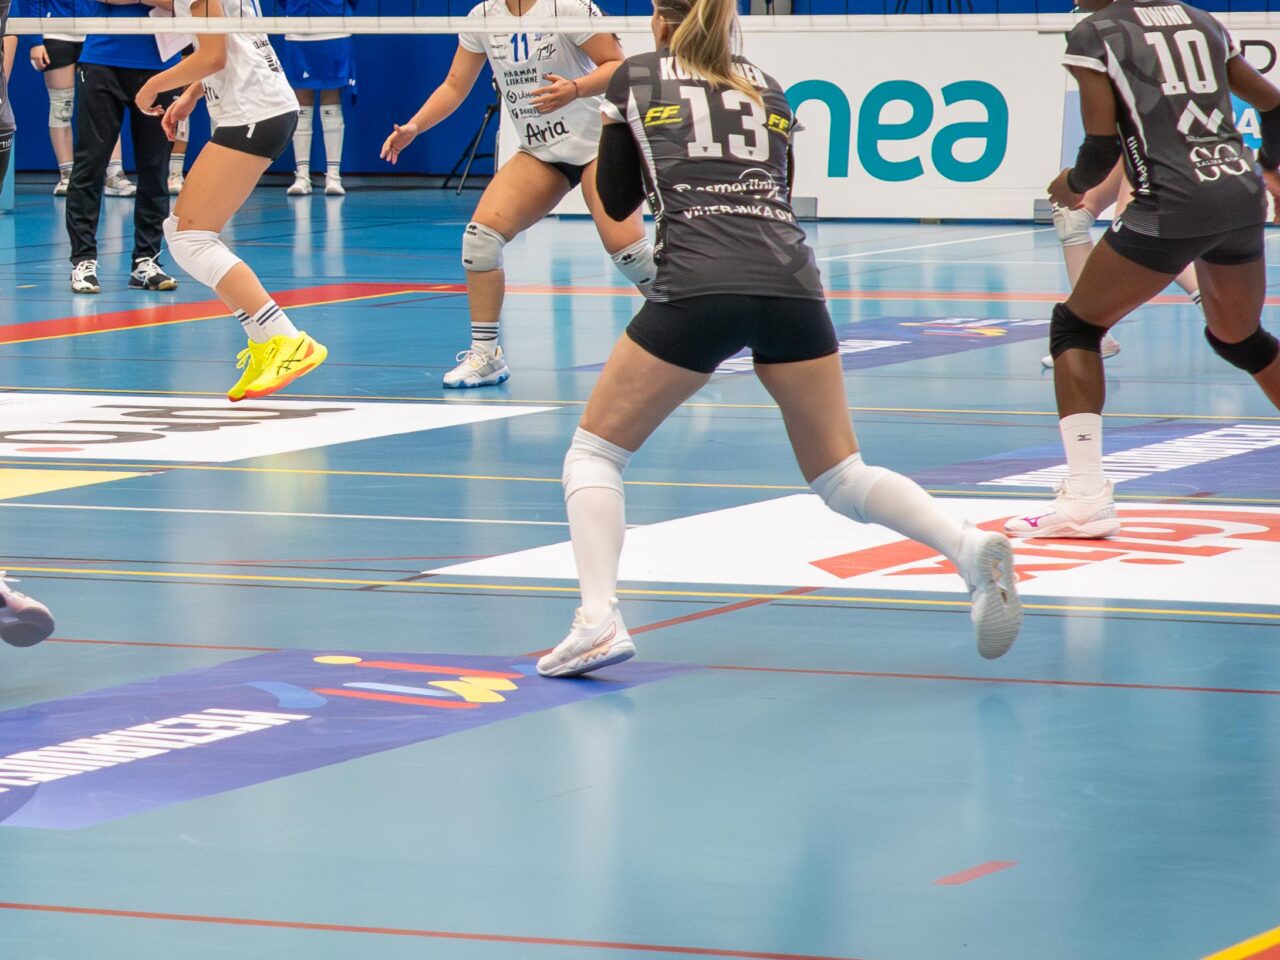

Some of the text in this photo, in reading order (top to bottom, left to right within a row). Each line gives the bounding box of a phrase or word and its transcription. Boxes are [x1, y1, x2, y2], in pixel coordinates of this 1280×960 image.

[510, 33, 529, 62] 11
[1144, 29, 1219, 96] 10
[524, 120, 570, 146] Atria
[679, 85, 770, 161] 13
